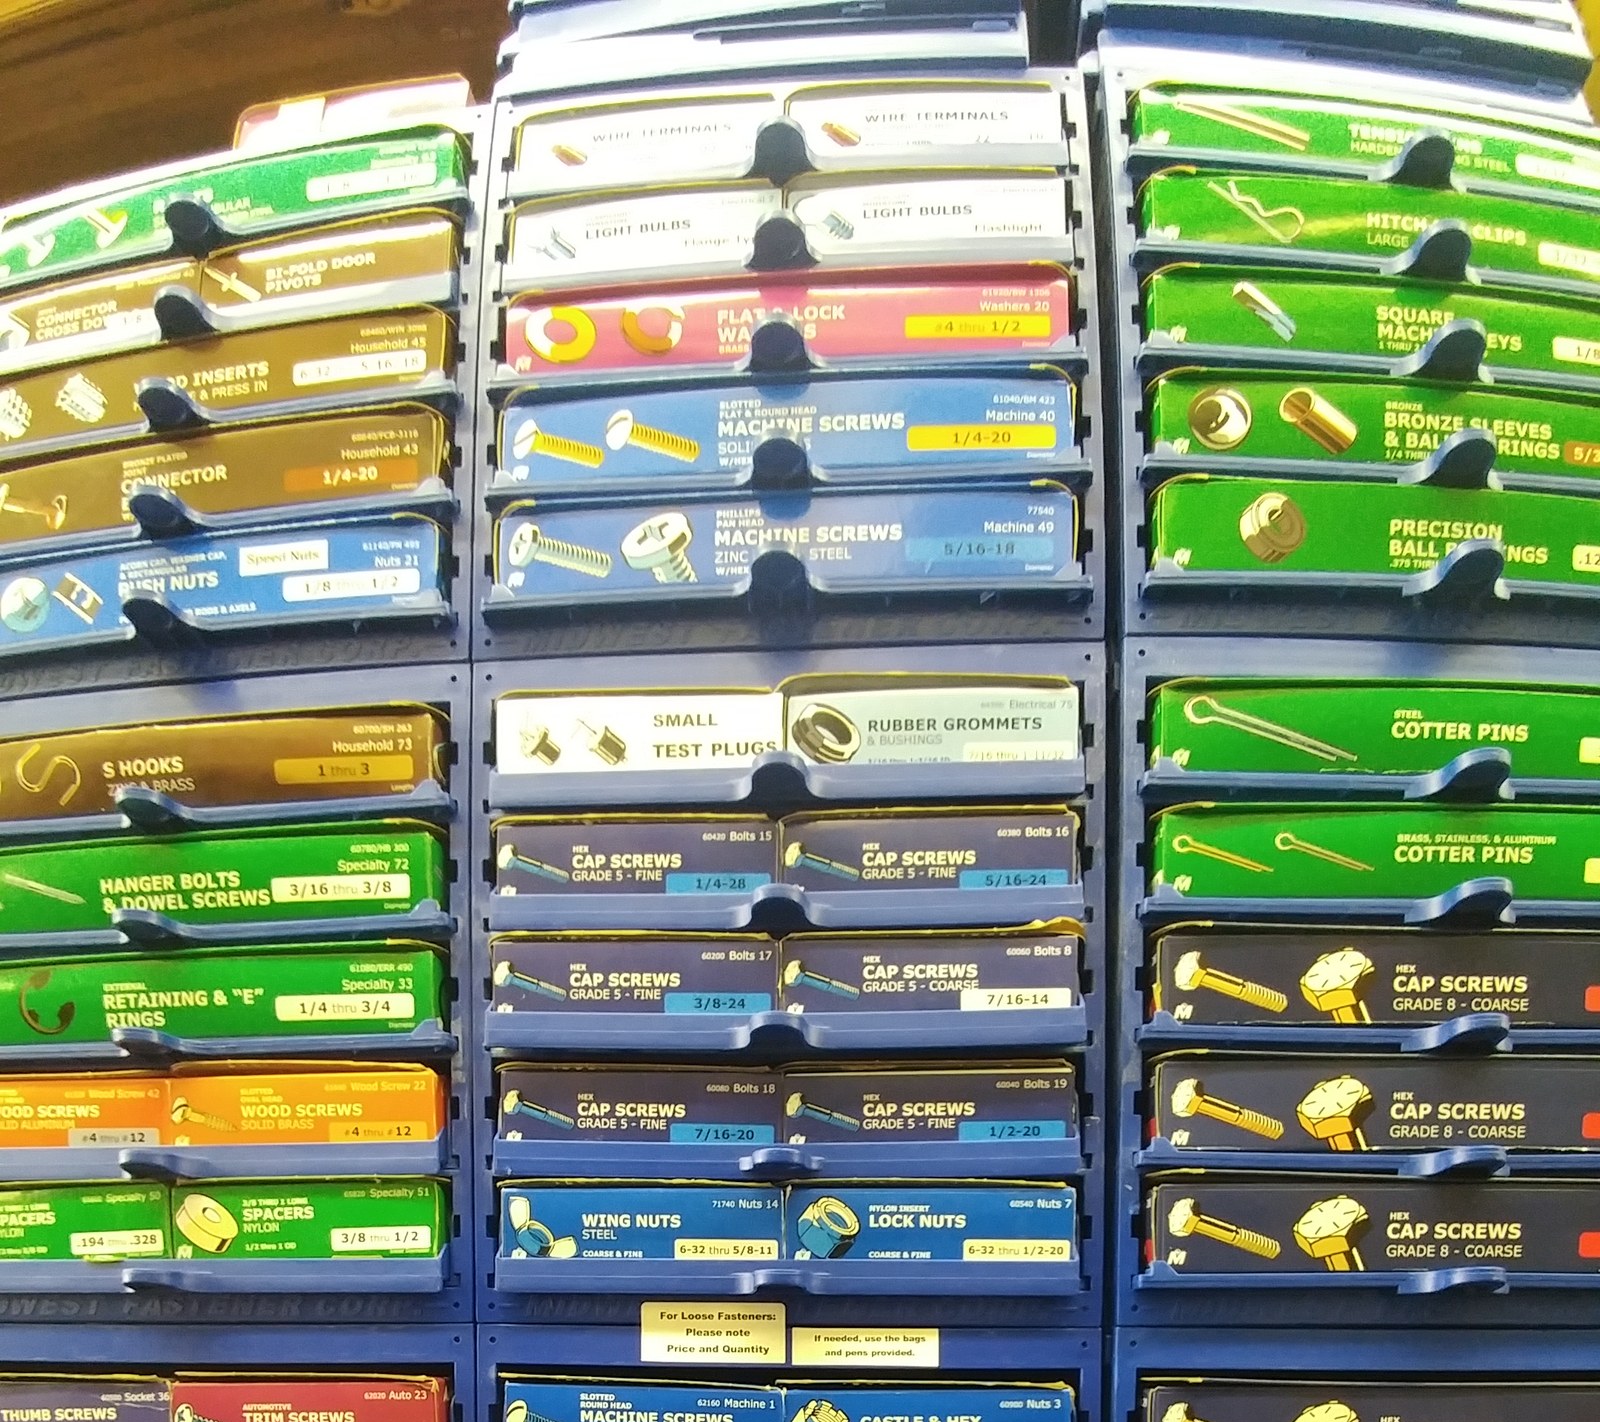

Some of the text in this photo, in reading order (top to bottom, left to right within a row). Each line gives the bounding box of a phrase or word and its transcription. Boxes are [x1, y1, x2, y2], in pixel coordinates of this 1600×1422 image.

[916, 111, 1009, 122] TERMINALS
[863, 204, 973, 218] LIGHT BULBS
[973, 222, 1044, 234] Flashlight
[1366, 233, 1408, 248] LARGE
[331, 252, 375, 271] DOOR
[265, 274, 322, 293] PIVOTS
[979, 301, 1050, 313] Washers 20
[1376, 306, 1454, 325] SQUARE
[351, 337, 426, 353] Household 45
[952, 431, 1011, 444] 1/4-20
[322, 467, 378, 485] 1/4-20
[716, 508, 761, 518] PHILLIPS
[716, 518, 764, 527] PAN HEAD
[1390, 519, 1502, 540] PRECISION
[944, 542, 1015, 556] 5/16-18
[375, 554, 418, 567] Nuts 21
[653, 713, 719, 728] SMALL
[867, 715, 1043, 733] RUBBER GROMMETS
[1391, 722, 1529, 742] COTTER PINS
[333, 738, 412, 753] Household 73
[653, 739, 778, 760] TEST PLUGS
[103, 757, 184, 778] S HOOKS
[337, 858, 409, 873] Specialty 72
[572, 852, 682, 869] CAP SCREWS
[100, 870, 240, 894] HANGER BOLTS
[695, 876, 747, 891] 1/4-28
[984, 872, 1047, 888] 5/16-24
[289, 879, 392, 897] 3/16 thru 3/8
[1393, 976, 1527, 993] CAP SCREWS
[103, 990, 208, 1010] RETAINING
[214, 991, 228, 1005] &
[299, 999, 391, 1015] 1/4 thru 3/4
[694, 996, 746, 1011] 3/8-24
[986, 992, 1049, 1007] 7/16-14
[106, 1011, 165, 1029] RINGS
[241, 1103, 362, 1118] WOOD SCREWS
[241, 1118, 314, 1130] SOLID BRASS
[989, 1123, 1040, 1139] 1/2-20
[694, 1127, 755, 1142] 7/16-20
[243, 1205, 314, 1221] SPACERS
[243, 1220, 280, 1234] NYLON
[581, 1213, 682, 1230] WING NUTS
[868, 1213, 966, 1229] LOCK NUTS
[581, 1228, 617, 1241] STEEL
[679, 1243, 772, 1258] 6-32 thru 5/8-11
[660, 1311, 776, 1322] For Loose Fasteners:
[686, 1326, 751, 1339] Please note
[814, 1334, 926, 1345] If needed, use the bags
[666, 1343, 769, 1356] Price and Quantity
[825, 1348, 915, 1359] and pens provided.
